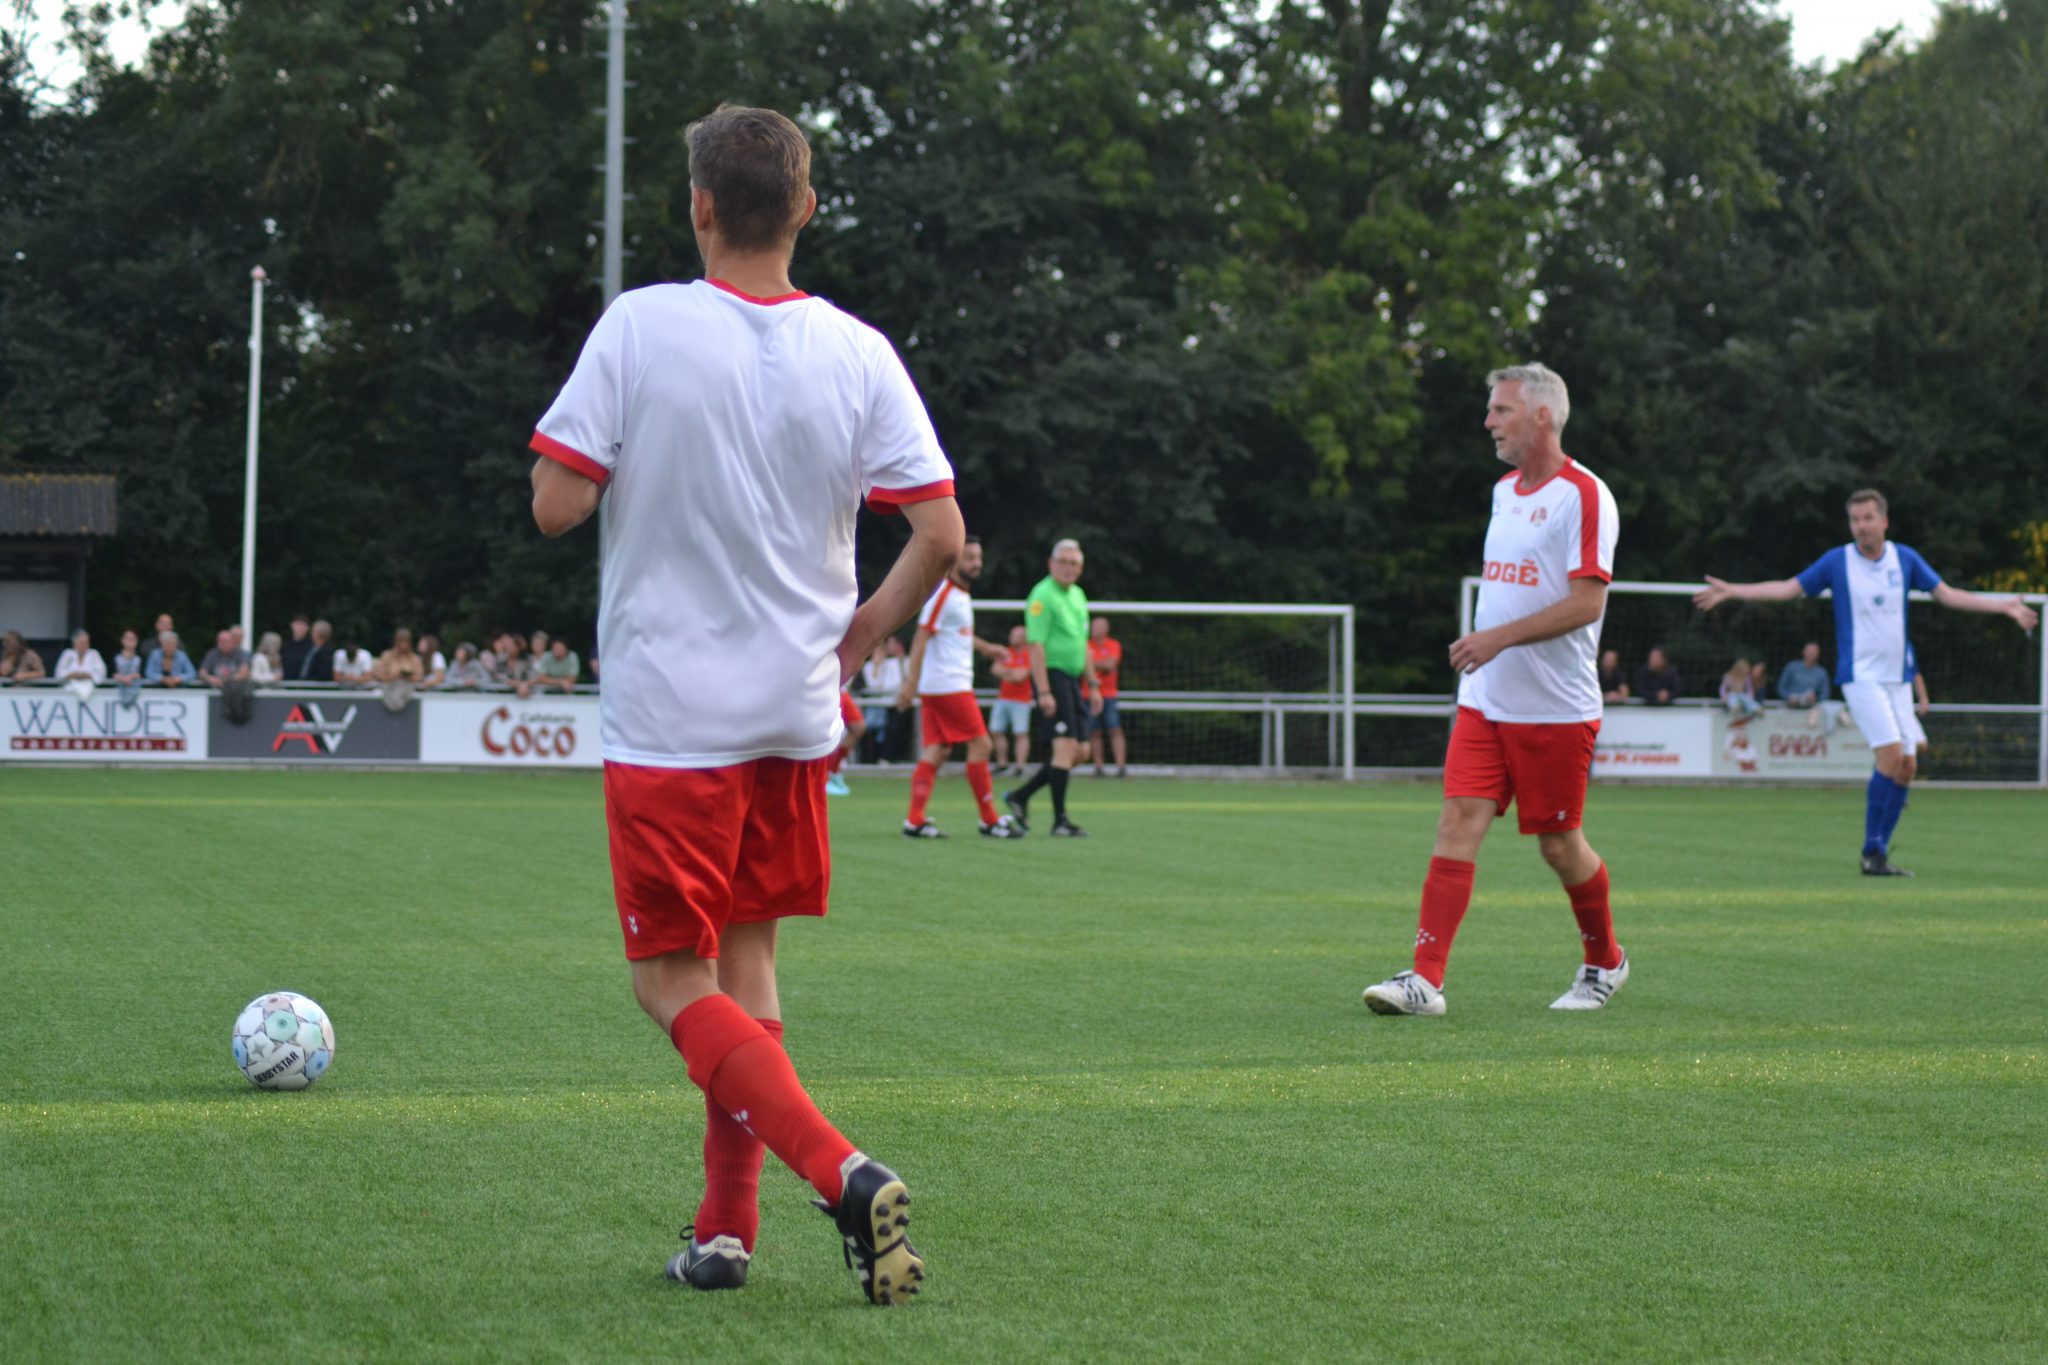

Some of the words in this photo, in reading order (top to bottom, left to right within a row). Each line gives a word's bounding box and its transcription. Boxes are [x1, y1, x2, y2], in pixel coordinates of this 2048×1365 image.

[10, 699, 188, 736] WANDER
[272, 702, 358, 754] AV
[12, 737, 187, 750] wanderauto.nl
